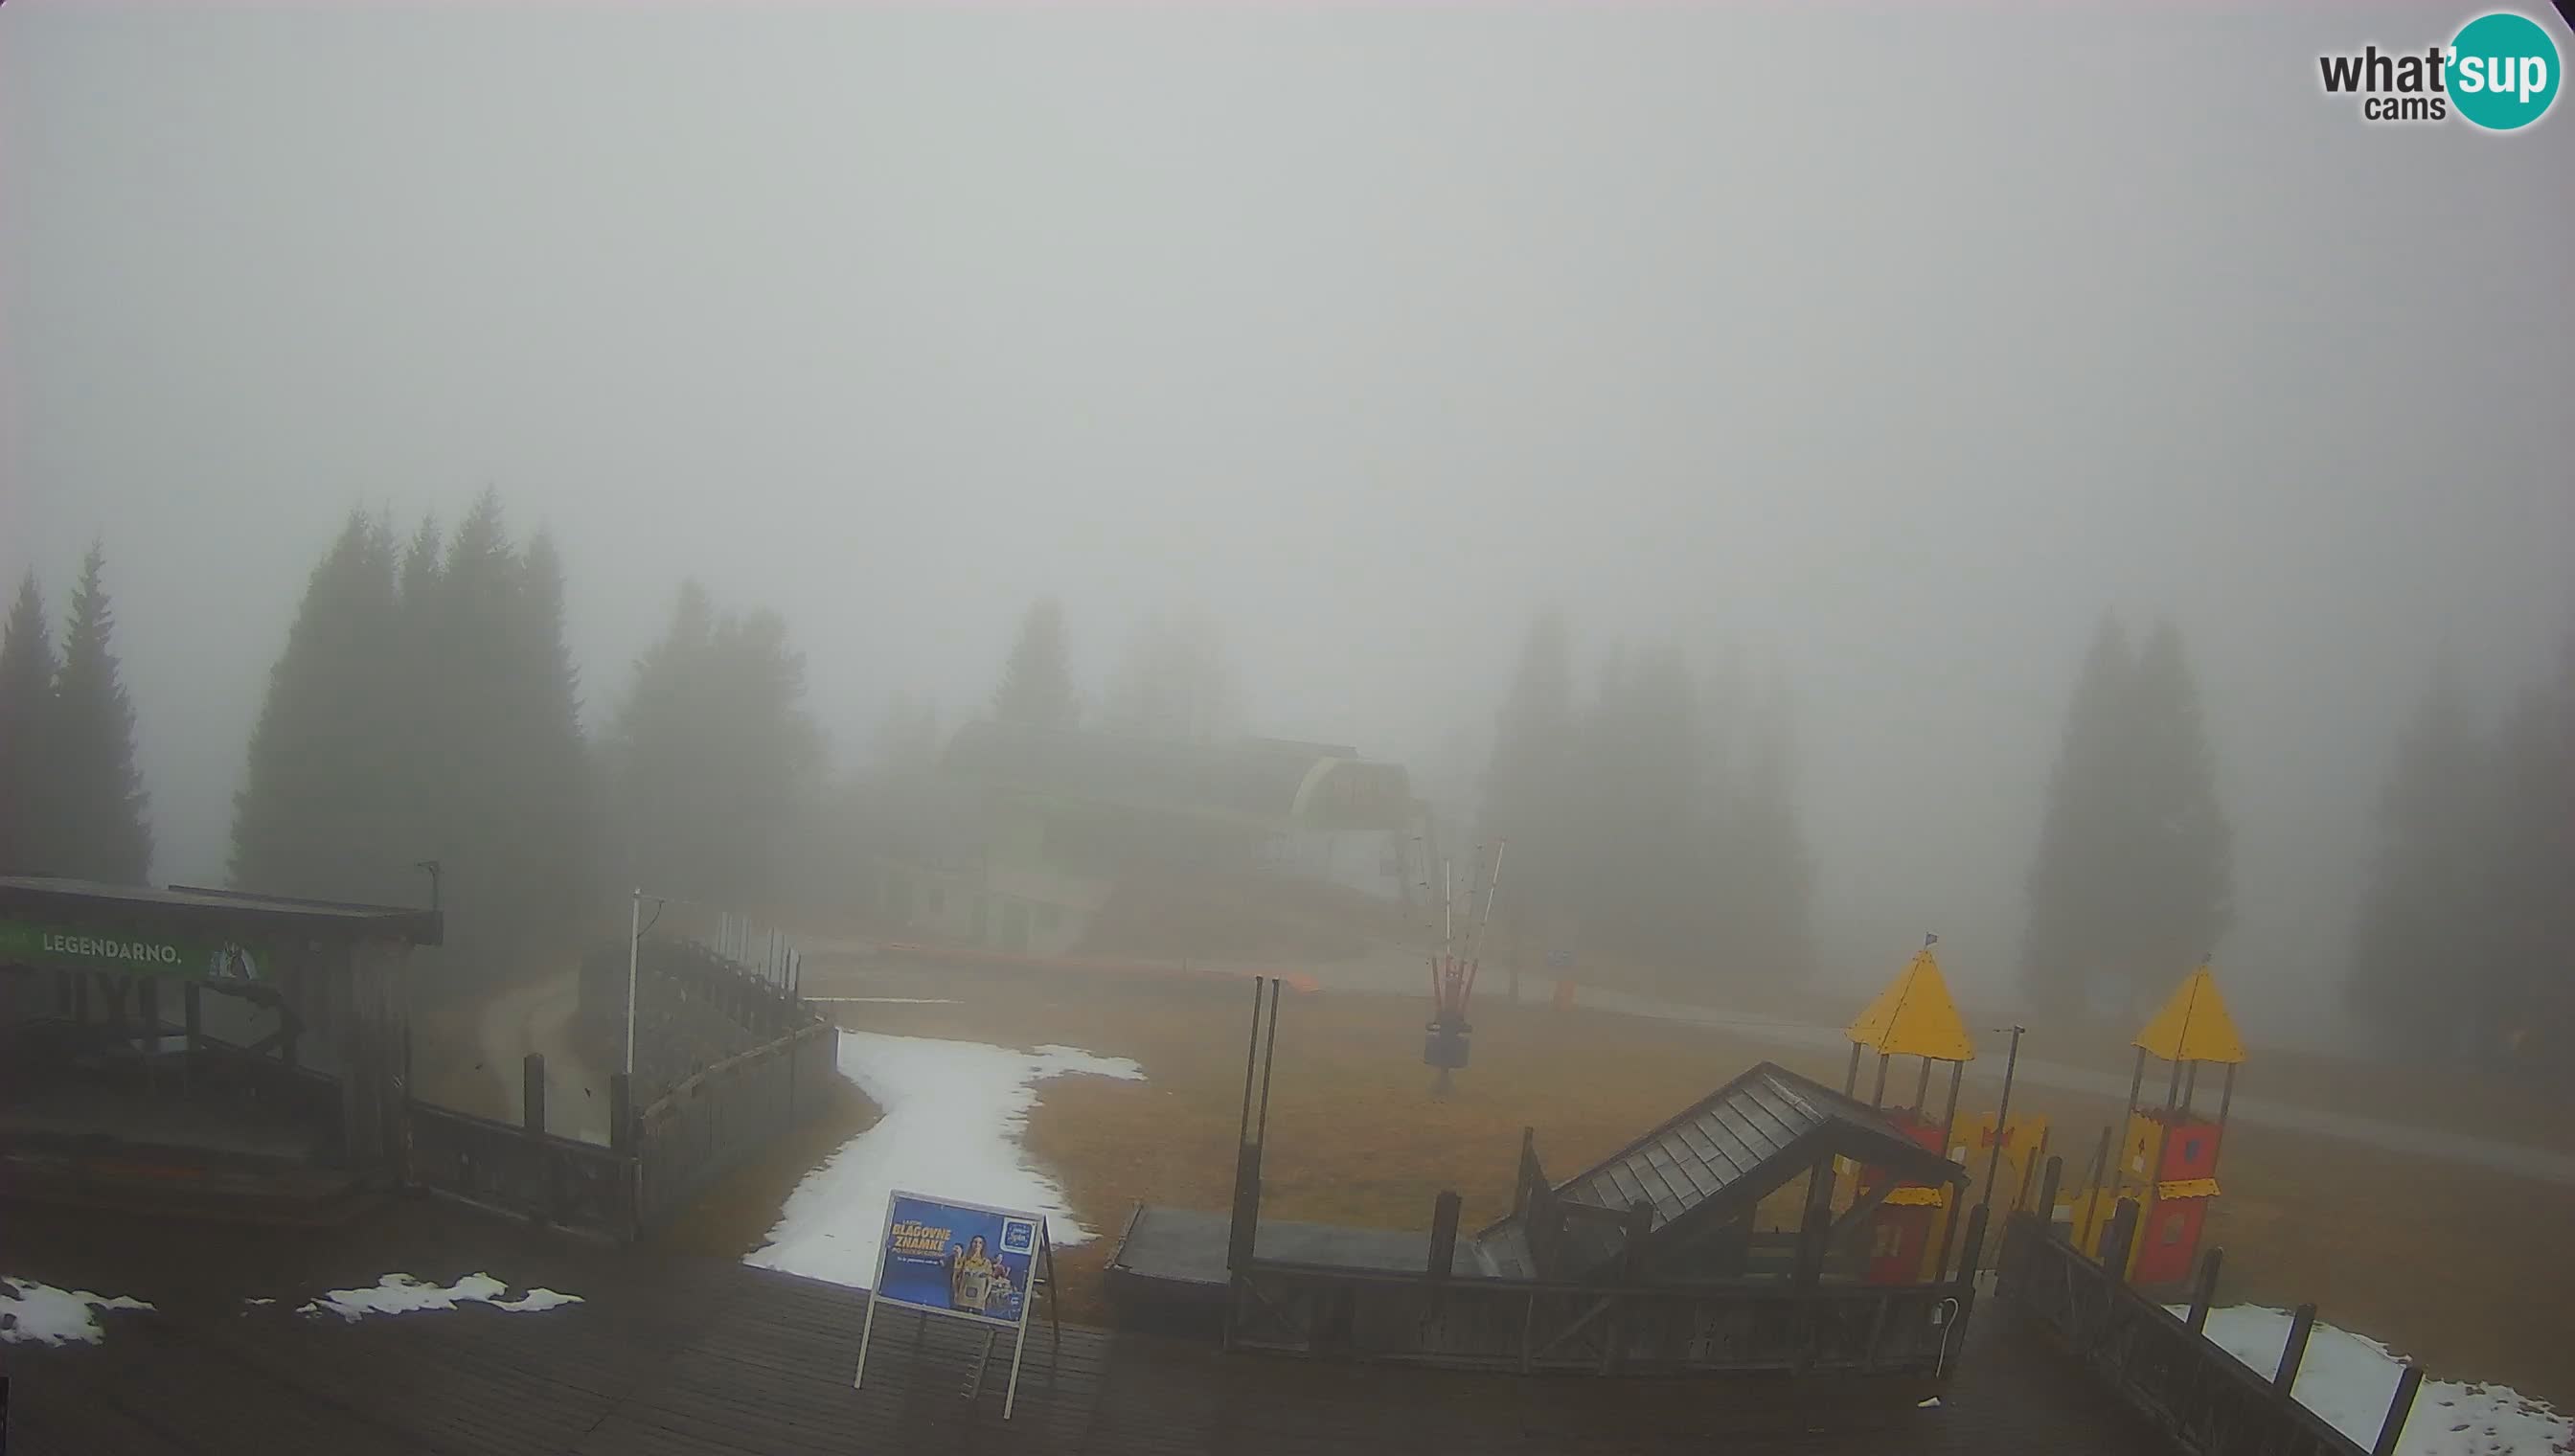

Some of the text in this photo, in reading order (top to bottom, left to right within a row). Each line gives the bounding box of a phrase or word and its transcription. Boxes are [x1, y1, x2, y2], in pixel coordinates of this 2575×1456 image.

[43, 934, 182, 965] LEGENDARNO.
[892, 1224, 951, 1240] BLAGOVNE
[895, 1236, 945, 1251] ZNAMKE
